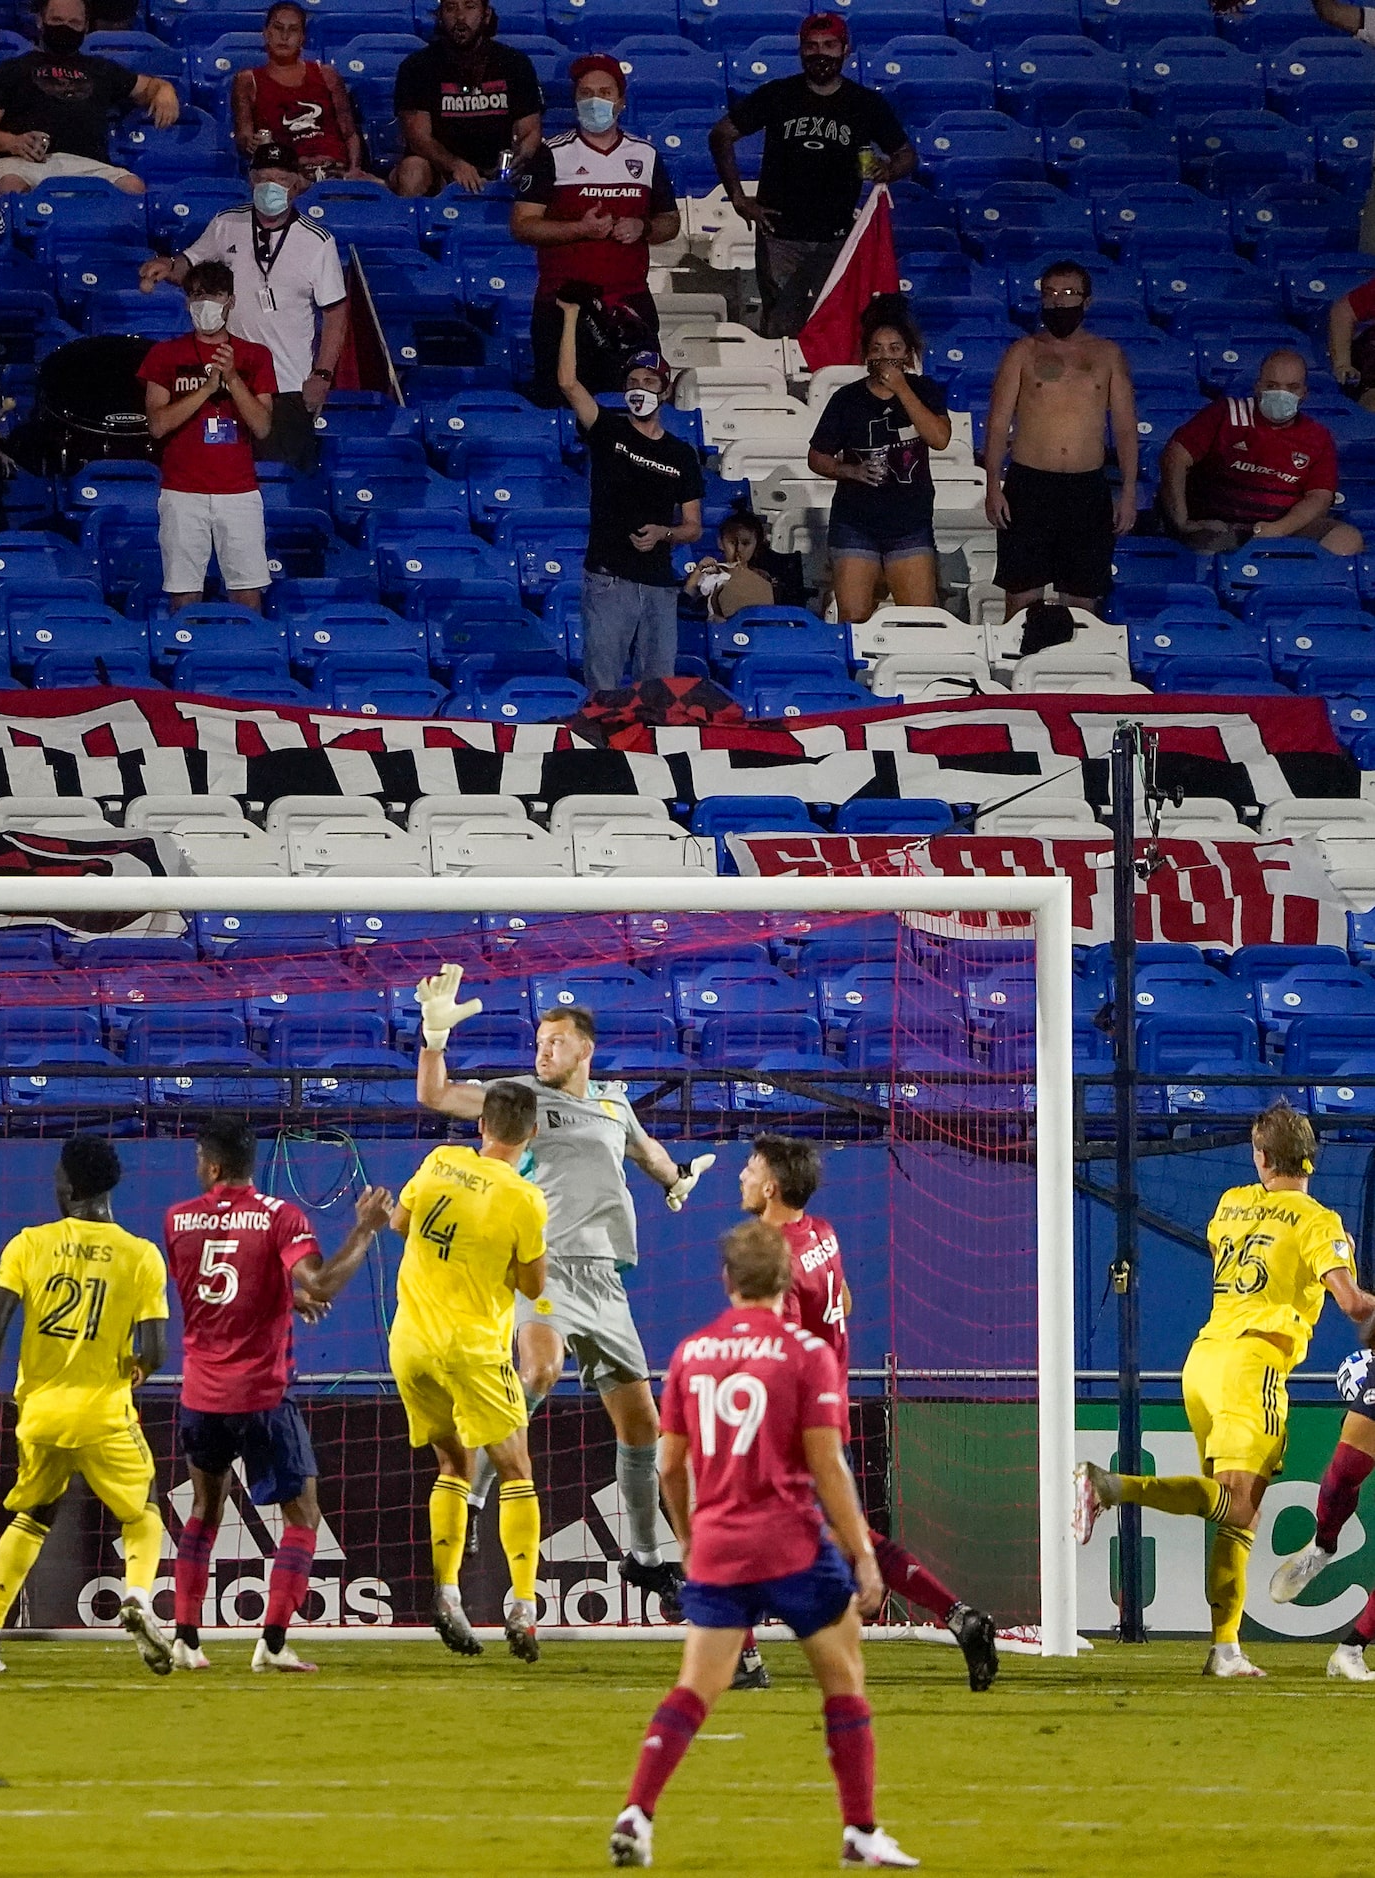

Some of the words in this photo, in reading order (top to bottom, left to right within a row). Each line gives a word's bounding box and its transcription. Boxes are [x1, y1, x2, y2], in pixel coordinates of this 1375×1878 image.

[441, 93, 508, 112] MATADOR
[783, 117, 852, 146] TEXAS
[579, 187, 643, 198] ADVOCARE
[615, 443, 629, 454] EL
[629, 452, 681, 477] MATADOR
[1230, 460, 1300, 485] ADVOCARE
[431, 1159, 494, 1195] ROMNEY
[173, 1213, 221, 1232] THIAGO
[221, 1211, 272, 1232] SANTOS
[420, 1194, 459, 1263] 4
[53, 1242, 114, 1263] JONES
[1212, 1233, 1276, 1295] 25
[198, 1239, 240, 1305] 5
[38, 1272, 107, 1342] 21
[682, 1337, 788, 1364] POMYKAL
[688, 1371, 768, 1457] 19
